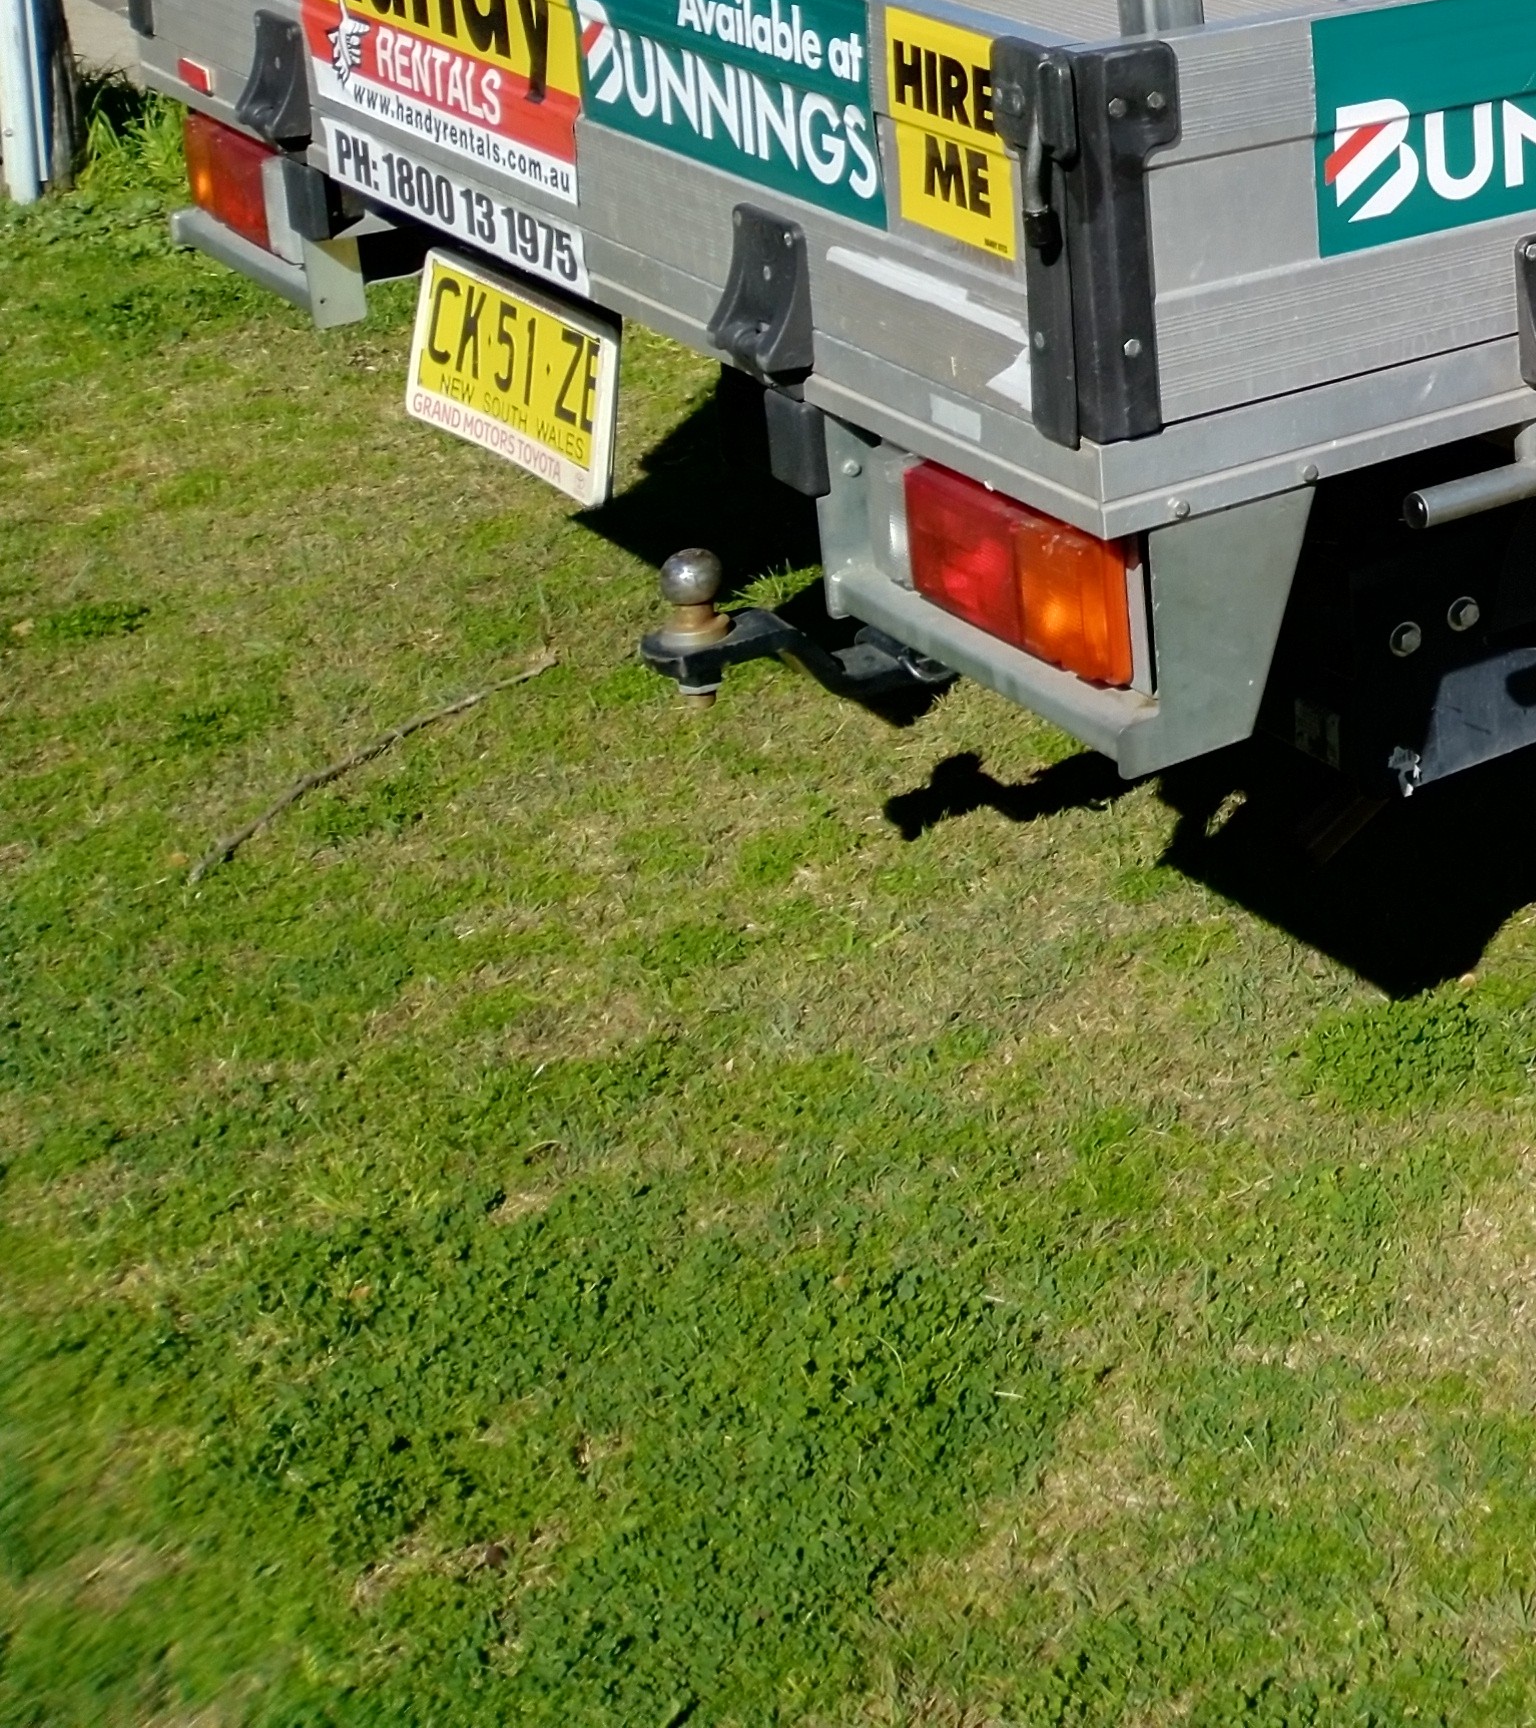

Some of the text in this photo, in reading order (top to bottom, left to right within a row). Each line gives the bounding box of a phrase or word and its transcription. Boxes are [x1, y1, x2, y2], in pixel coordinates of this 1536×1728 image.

[375, 26, 502, 125] RENTALS
[828, 33, 863, 83] at
[892, 39, 996, 136] HIRE
[353, 83, 571, 194] www.handyrentals.com.au
[924, 134, 992, 219] ME
[336, 132, 578, 281] PH: 1800 13 1975
[413, 392, 562, 483] GRAND MOTORS TOYOTA
[440, 373, 584, 460] NEW SOUTH WALES
